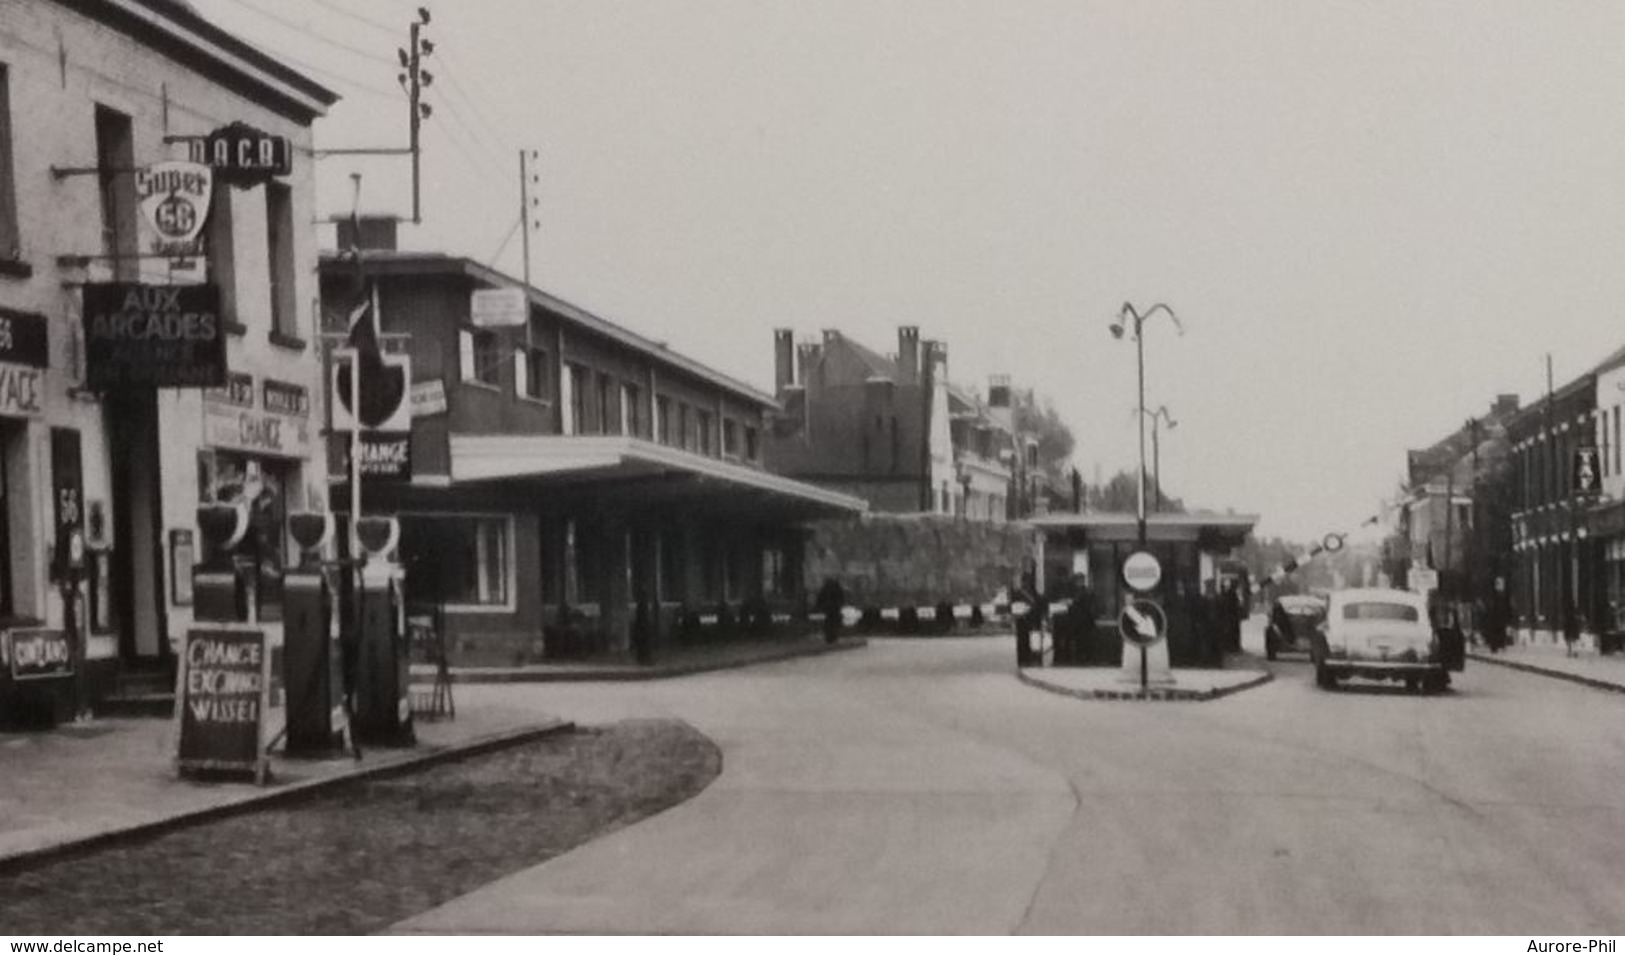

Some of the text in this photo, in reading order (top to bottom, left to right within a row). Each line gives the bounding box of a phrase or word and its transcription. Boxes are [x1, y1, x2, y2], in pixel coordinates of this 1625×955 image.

[136, 167, 208, 198] Super
[123, 287, 181, 312] AUX
[92, 312, 216, 341] ARCADES
[354, 439, 409, 463] HANGE
[188, 639, 261, 667] CHANGE
